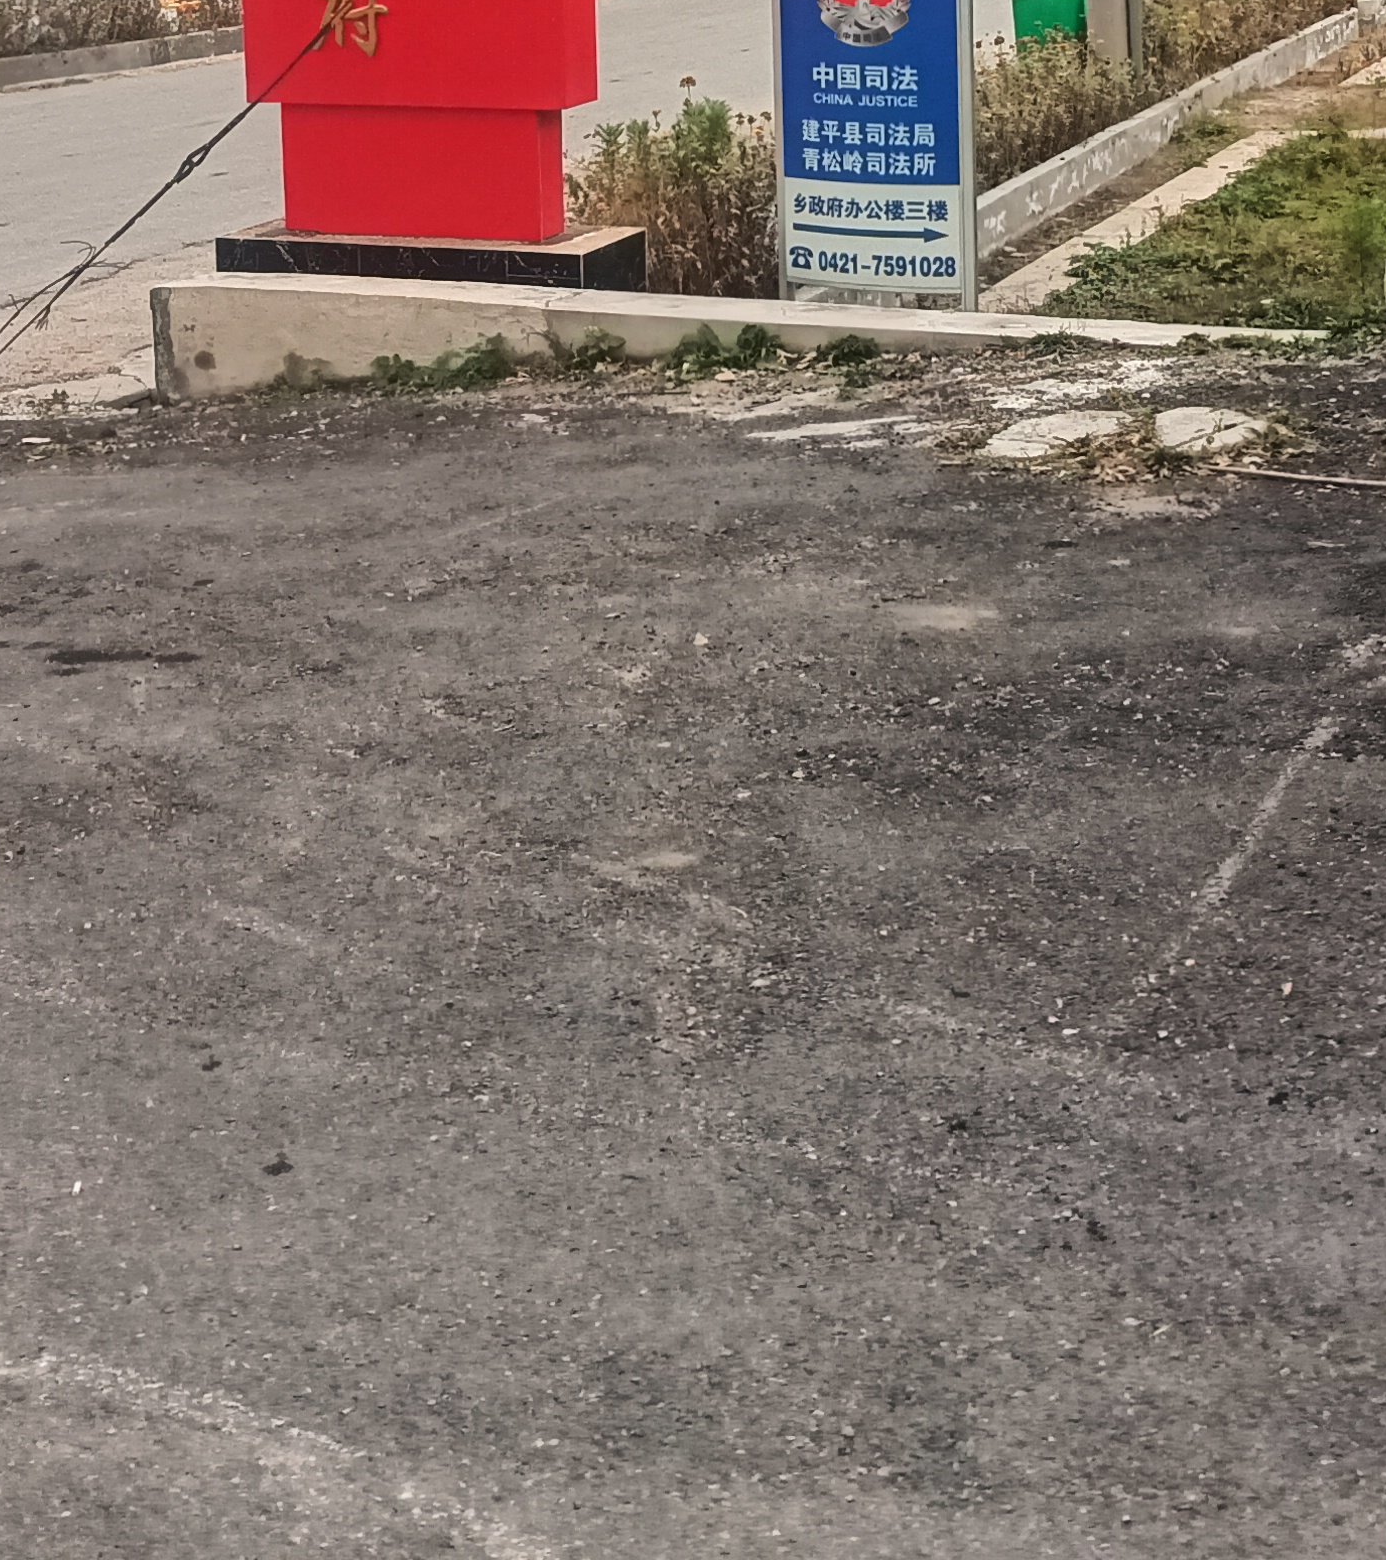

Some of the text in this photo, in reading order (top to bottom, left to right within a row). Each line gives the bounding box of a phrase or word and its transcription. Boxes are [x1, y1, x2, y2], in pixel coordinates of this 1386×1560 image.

[812, 62, 918, 92] 中国司法
[813, 92, 918, 108] CHINA JUSTICE
[801, 118, 936, 147] 建平县司法局
[801, 147, 936, 177] 青松岭司法所
[793, 193, 949, 223] 乡政府办公楼三楼
[818, 250, 956, 279] 0421-7591028
